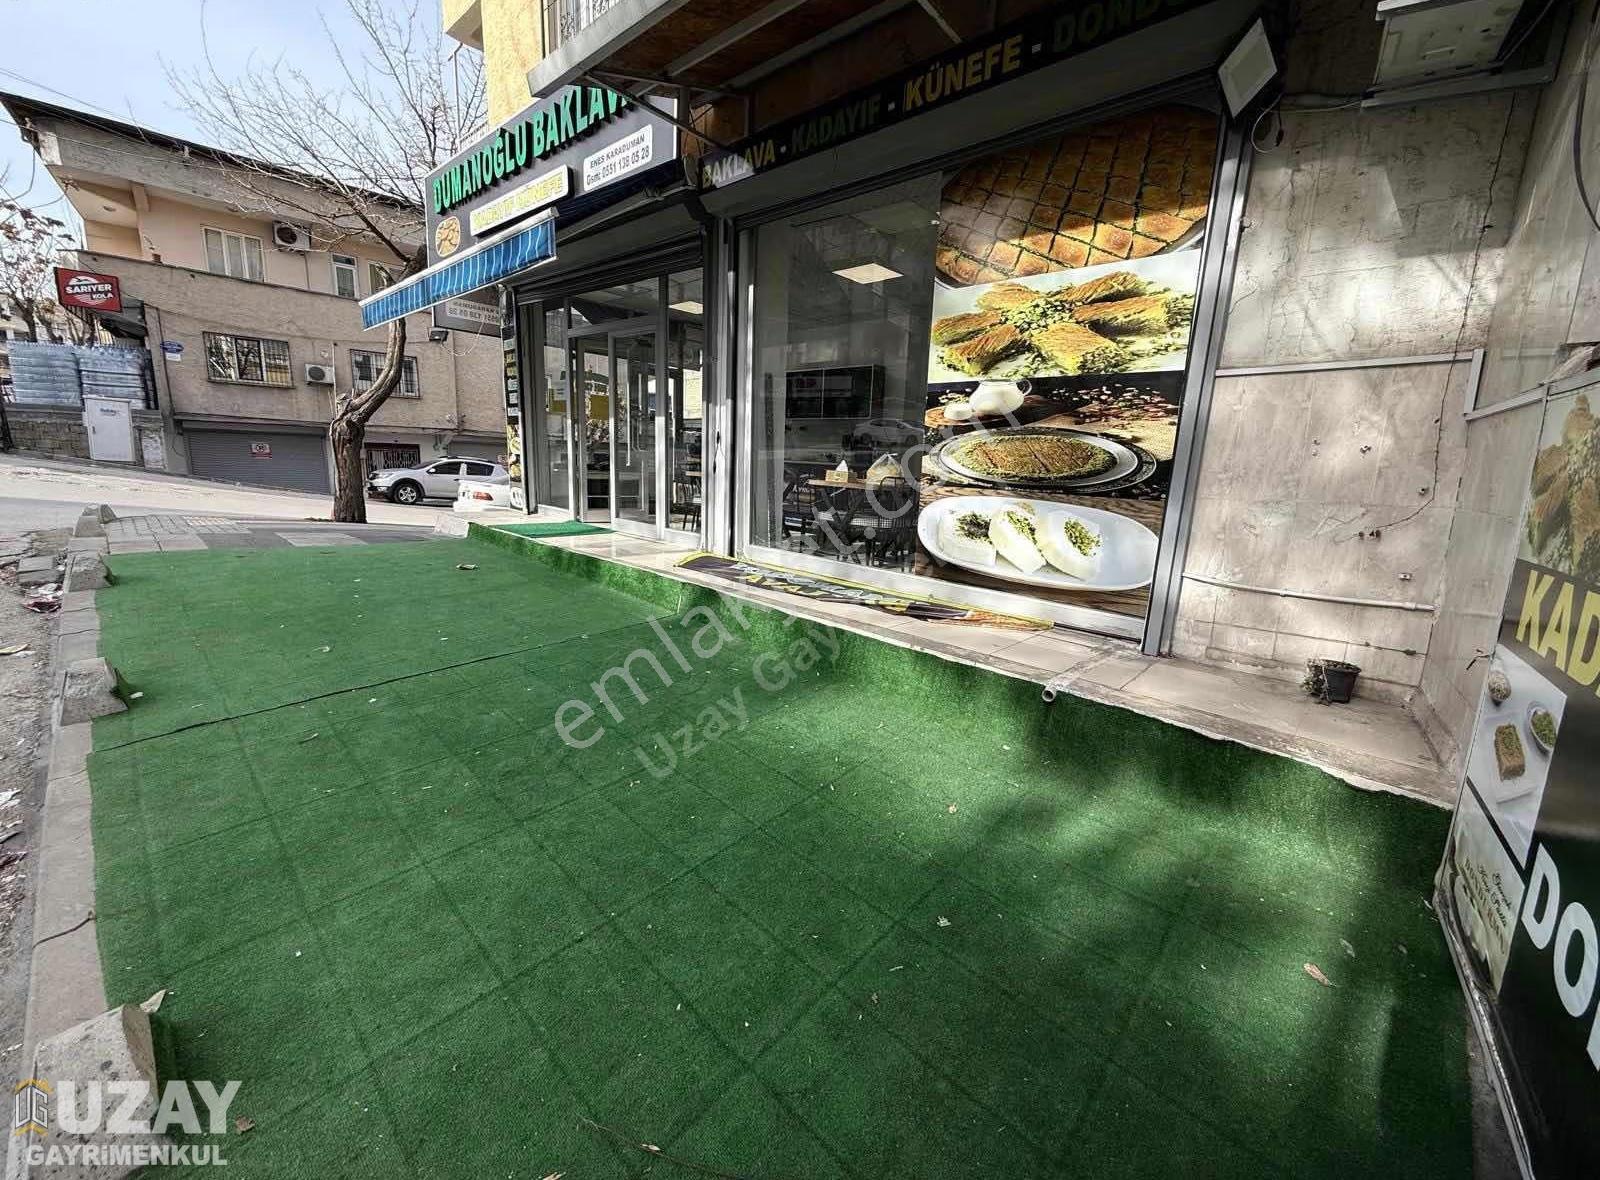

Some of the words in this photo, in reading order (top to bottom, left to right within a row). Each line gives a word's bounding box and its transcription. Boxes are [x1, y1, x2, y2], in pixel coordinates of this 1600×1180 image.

[432, 121, 527, 214] DUMANOĞLU
[532, 85, 628, 157] BAKLAV
[590, 155, 605, 169] ENES
[606, 133, 645, 161] KARADUMAN
[701, 143, 776, 187] BAKLAVA
[791, 91, 883, 158] KADAYIF
[904, 34, 1024, 112] KÜNEFE
[1515, 569, 1600, 698] KAD
[1521, 843, 1600, 1072] DO
